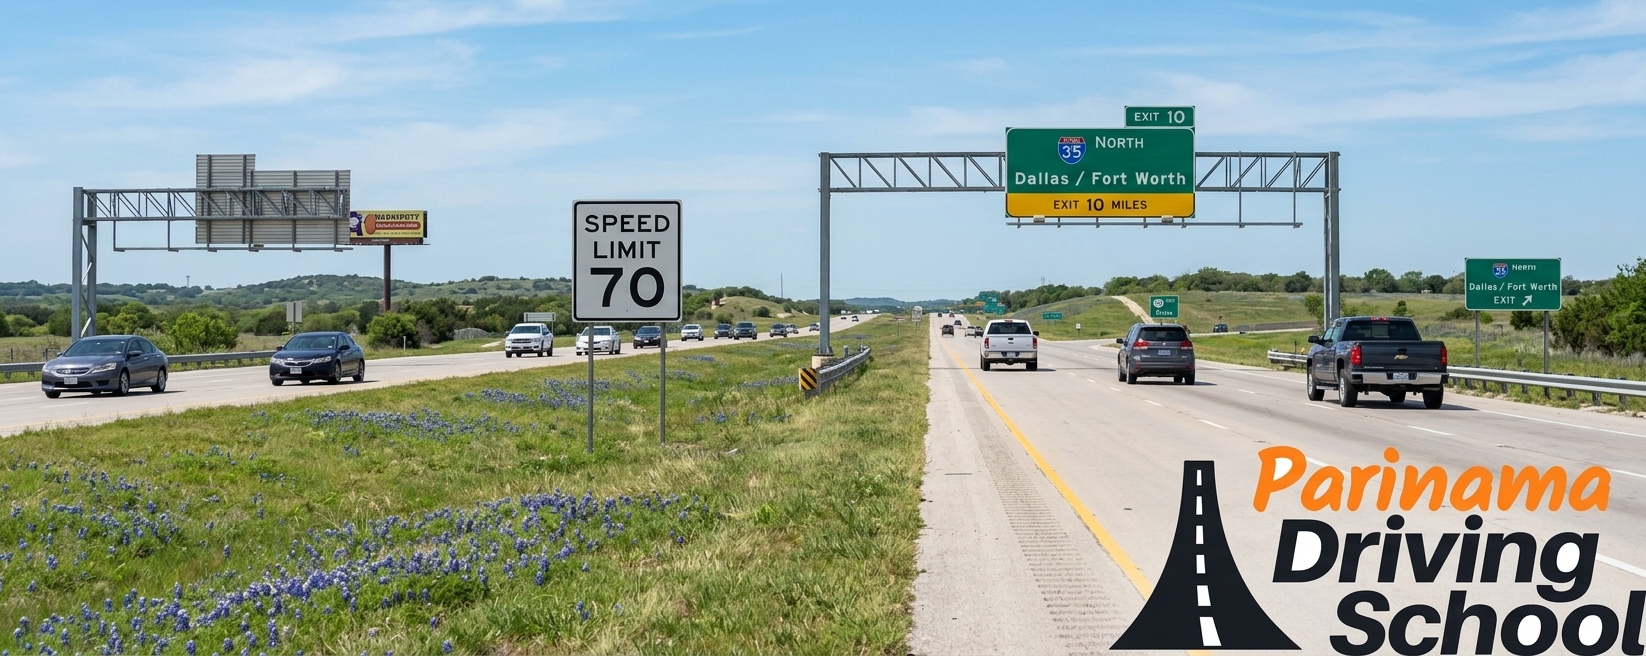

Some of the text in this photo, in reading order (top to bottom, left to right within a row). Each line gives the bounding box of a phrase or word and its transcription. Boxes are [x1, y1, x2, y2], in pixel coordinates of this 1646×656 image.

[1134, 110, 1185, 124] EXIT 10
[1062, 145, 1081, 158] 35
[1095, 136, 1144, 149] NORTH
[1015, 170, 1186, 186] Dallas / Fort Worth
[1053, 198, 1147, 212] EXIT 10 MILES
[584, 214, 670, 233] SPEED
[593, 240, 661, 259] LIMIT
[590, 266, 665, 308] 70
[1507, 282, 1527, 291] Fort
[1493, 296, 1516, 304] EXIT
